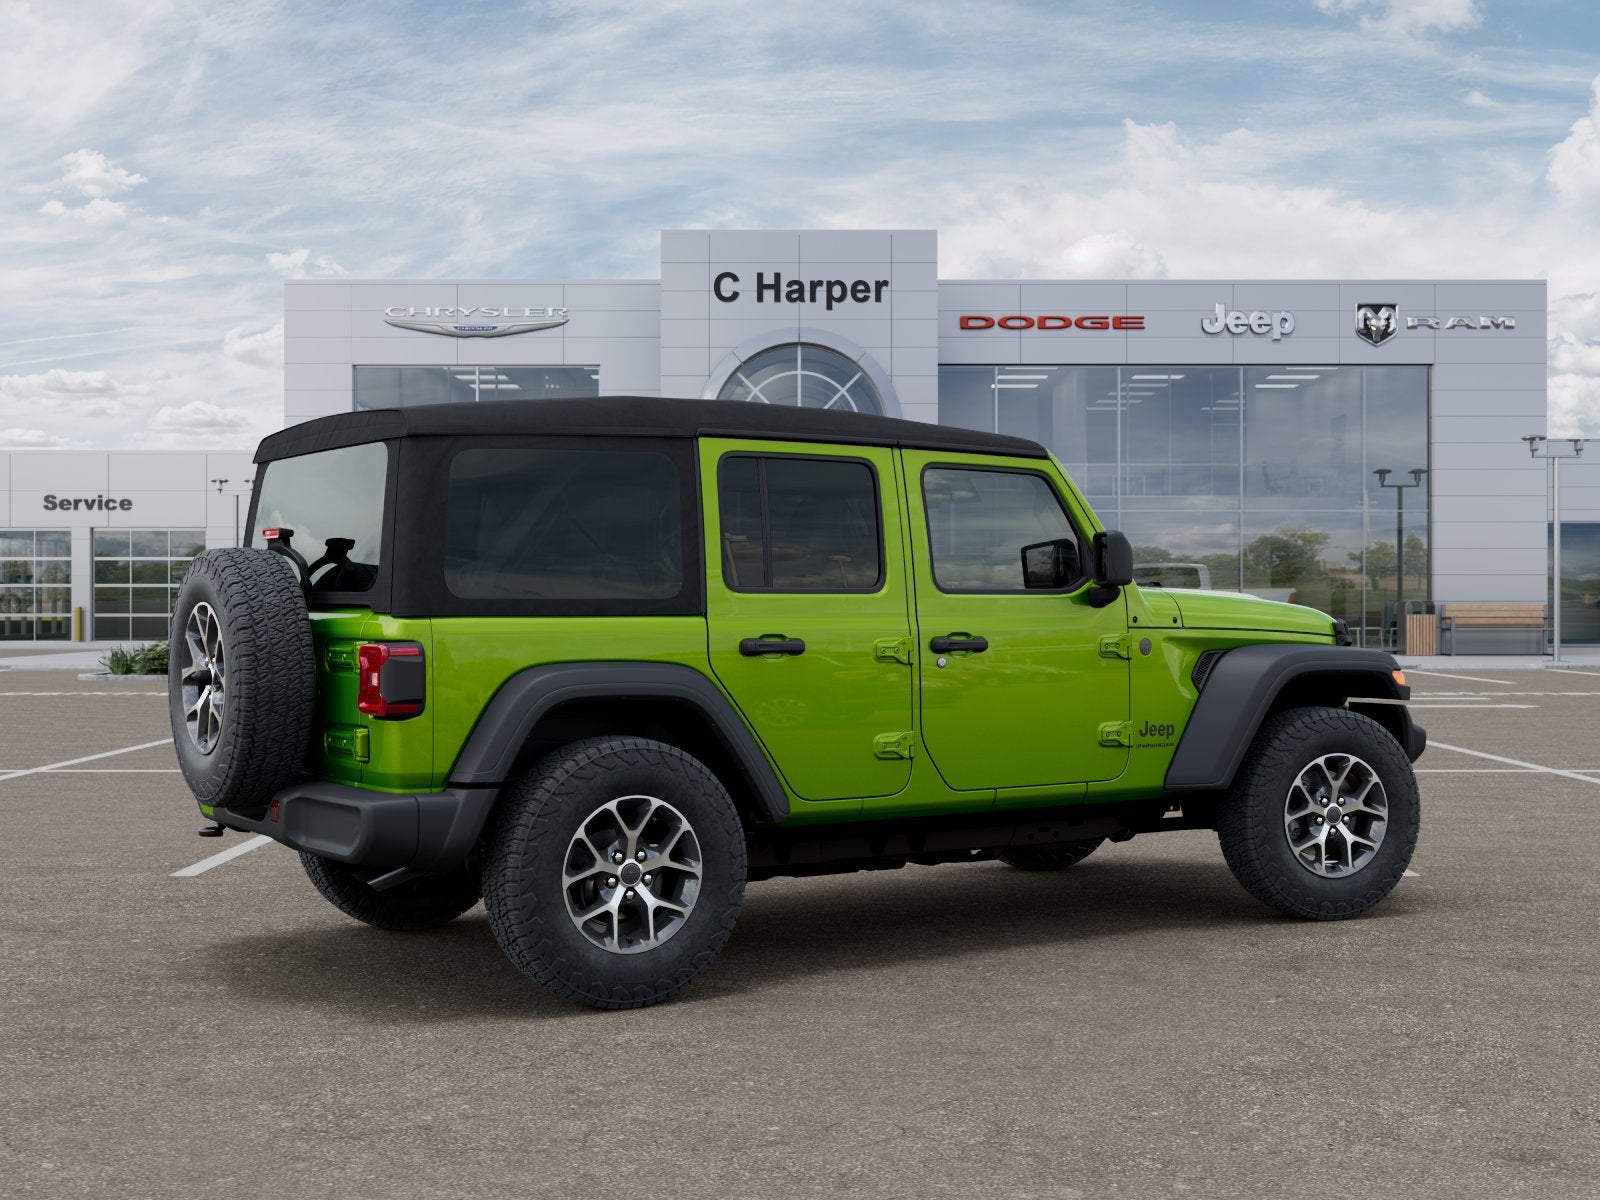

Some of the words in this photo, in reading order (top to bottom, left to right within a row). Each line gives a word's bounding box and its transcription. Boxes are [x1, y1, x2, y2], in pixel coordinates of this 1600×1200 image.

[713, 271, 740, 303] C
[756, 271, 890, 311] Harper
[384, 305, 569, 318] CHRYSLER
[959, 315, 1146, 330] DODGE
[1201, 302, 1296, 342] Jeep
[1406, 315, 1516, 330] RAM
[42, 494, 133, 511] Service
[1138, 719, 1175, 740] Jeep
